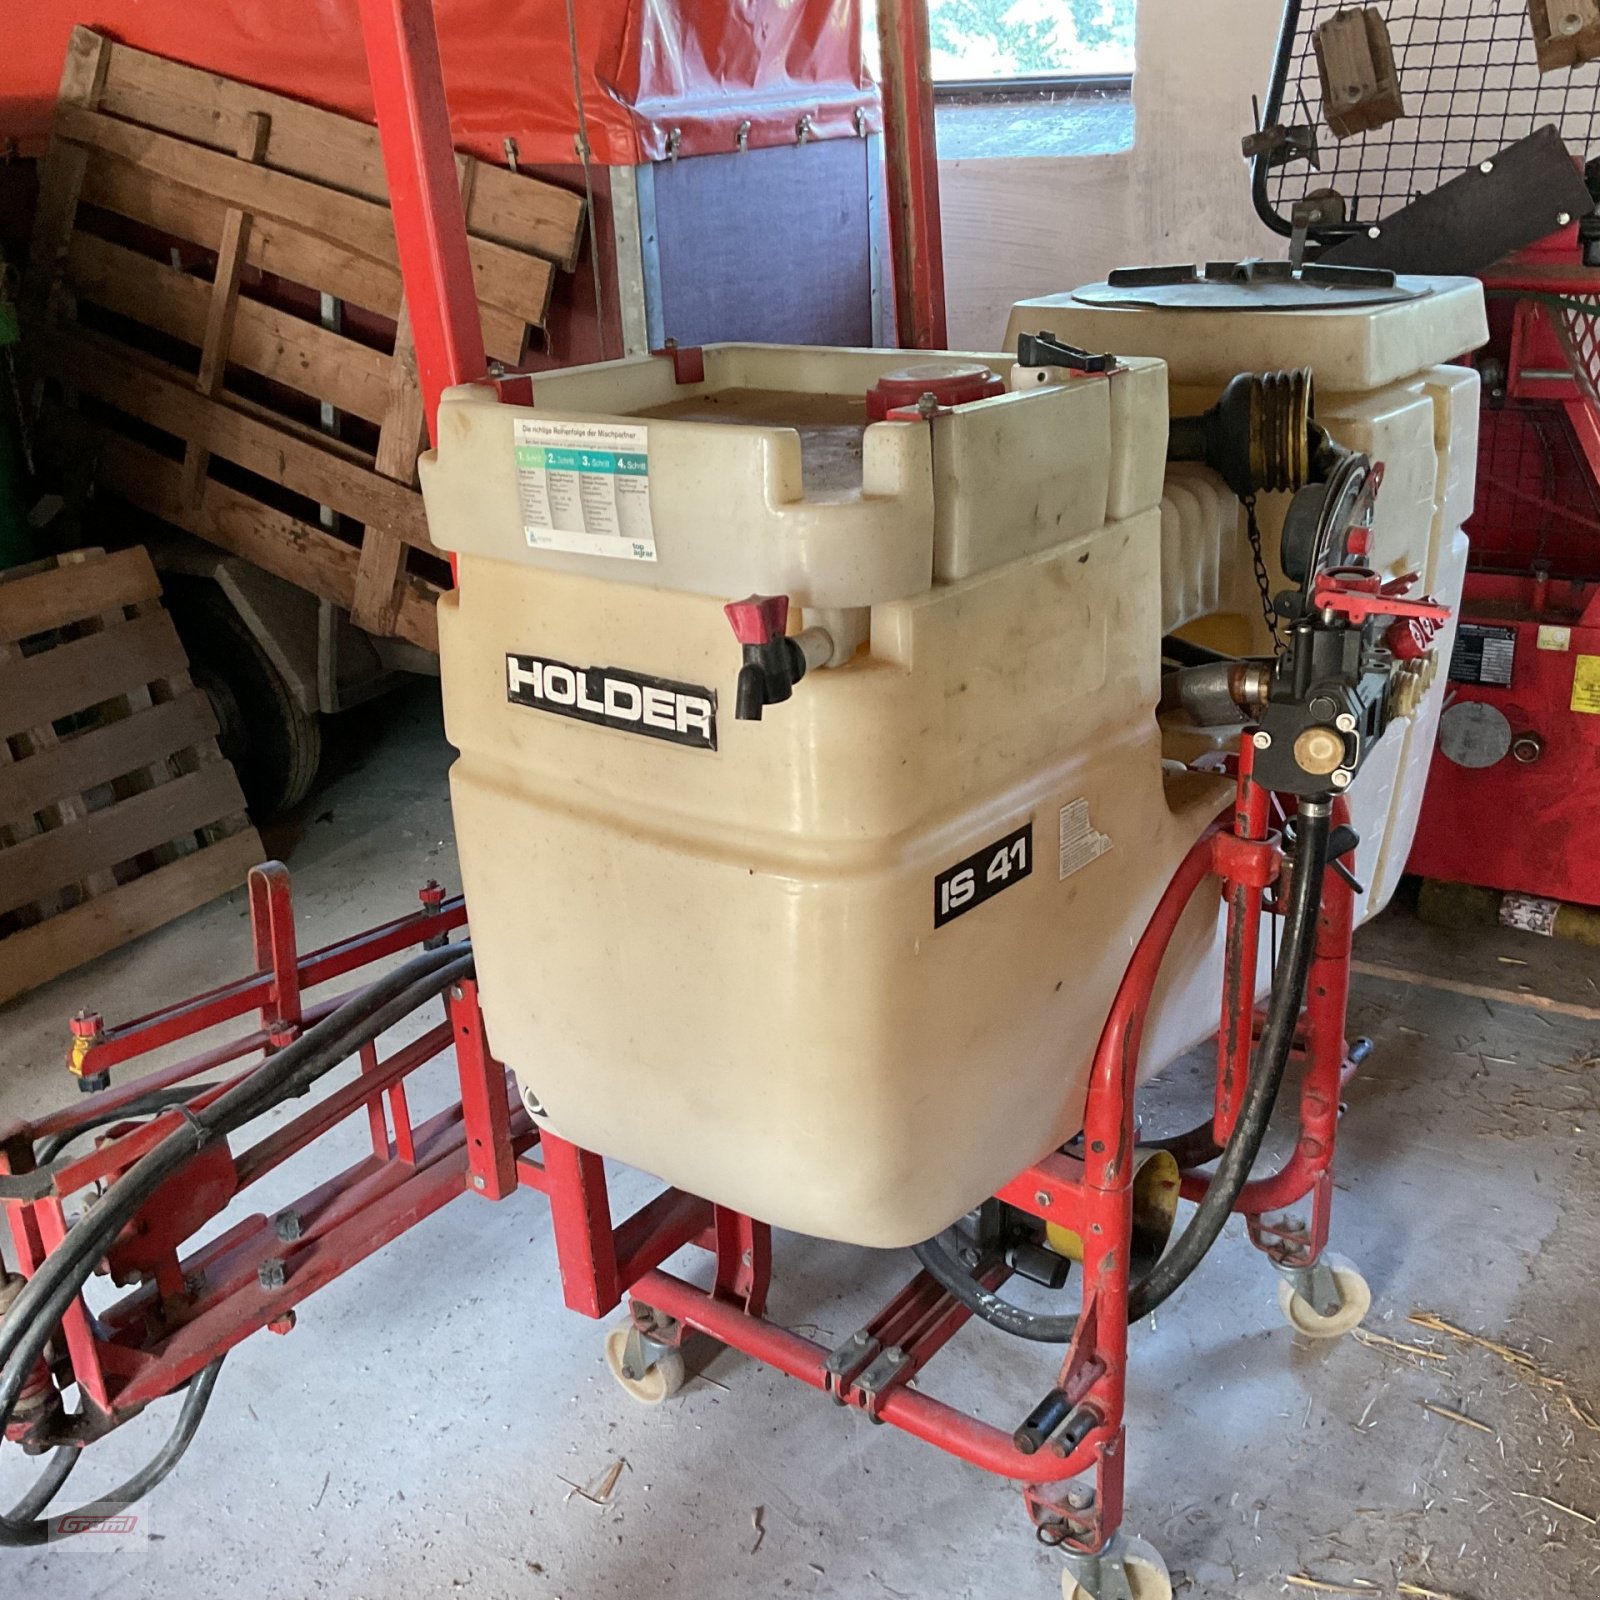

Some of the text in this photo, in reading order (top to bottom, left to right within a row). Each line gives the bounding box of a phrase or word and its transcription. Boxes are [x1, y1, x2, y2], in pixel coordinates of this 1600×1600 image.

[532, 426, 552, 435] richtige
[553, 427, 585, 437] Reihenfolge
[598, 430, 636, 439] Mischpartner
[548, 453, 556, 464] 2.
[582, 455, 610, 467] 3. Schritt
[617, 458, 646, 470] 4. Schritt
[632, 542, 644, 552] top
[633, 549, 653, 558] agrar
[507, 657, 711, 739] HOLDER
[941, 868, 975, 915] IS
[986, 836, 1026, 883] 41
